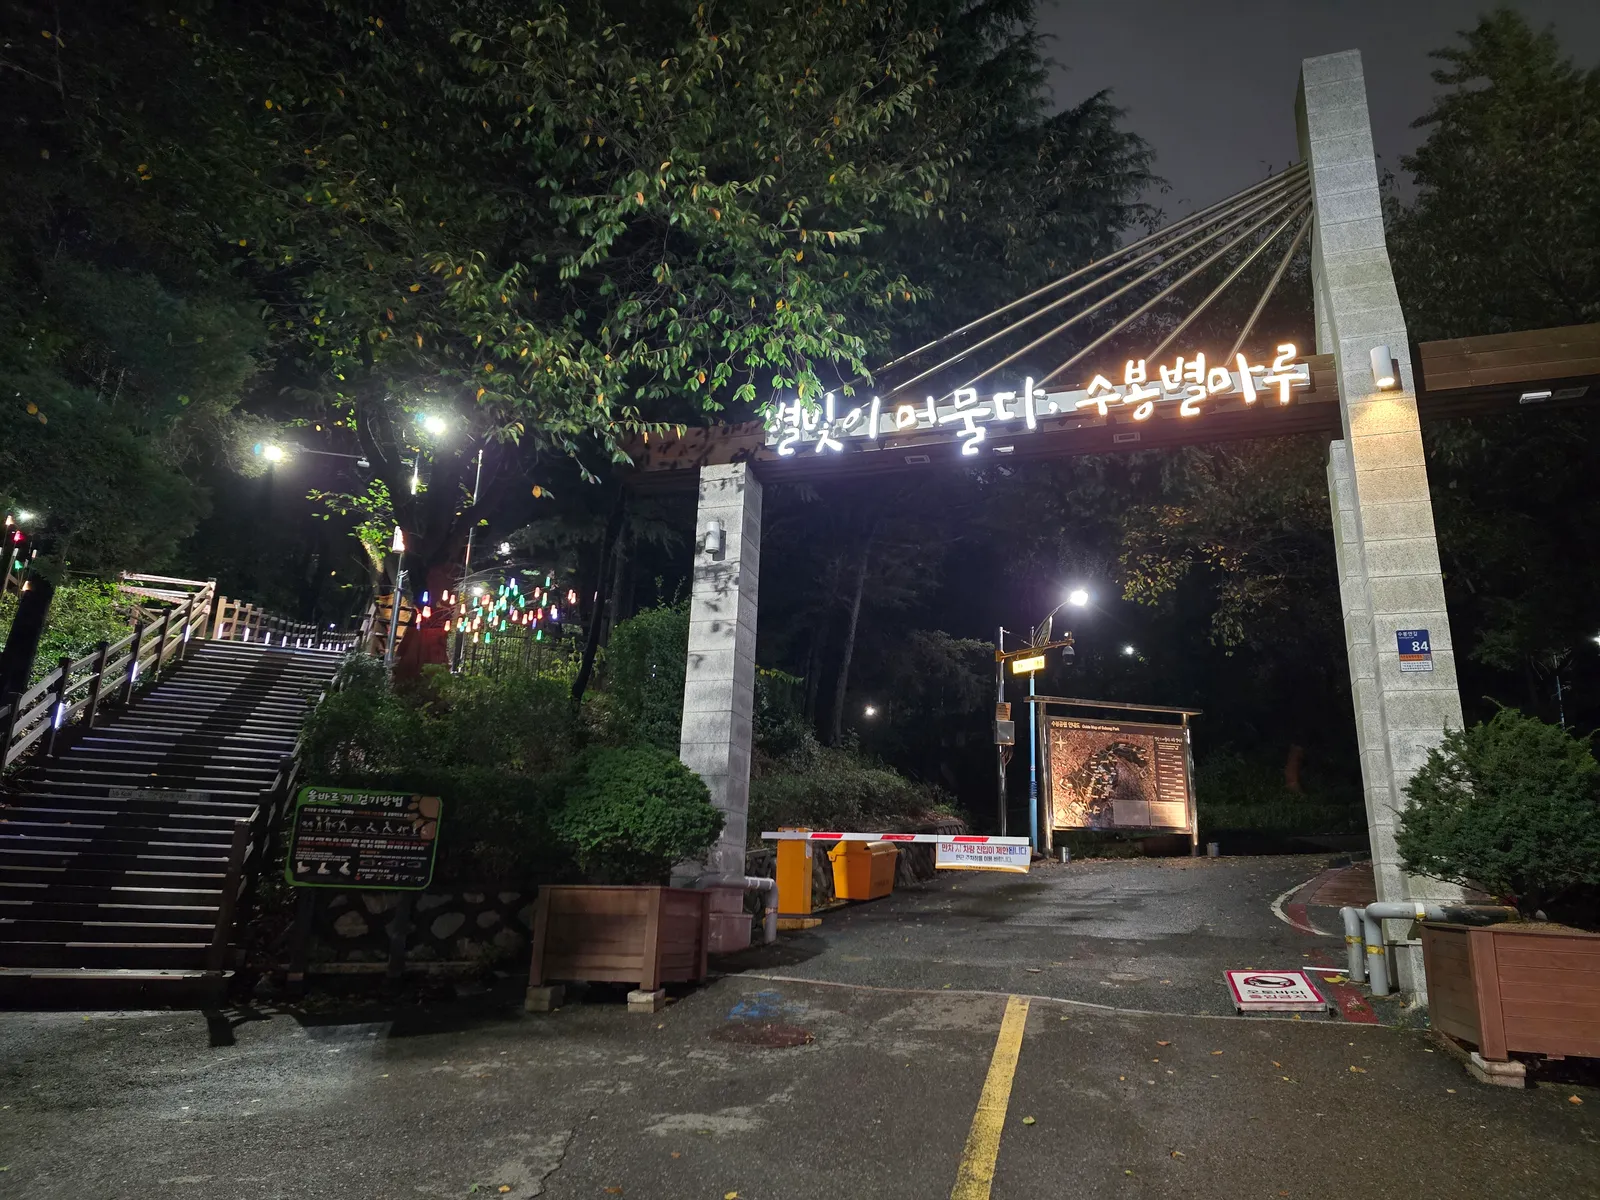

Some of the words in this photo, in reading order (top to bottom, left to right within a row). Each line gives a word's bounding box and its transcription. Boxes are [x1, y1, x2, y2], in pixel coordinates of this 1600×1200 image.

[766, 391, 881, 457] 별빛이
[1074, 343, 1308, 421] 수봉별마루
[1411, 641, 1429, 652] 84
[307, 789, 354, 803] 올바르게
[357, 793, 404, 807] 걷기방법
[941, 844, 954, 853] 만차
[955, 844, 962, 853] 시
[963, 845, 975, 853] 차량
[976, 845, 995, 855] 진입이
[996, 846, 1027, 856] 제한됩니다
